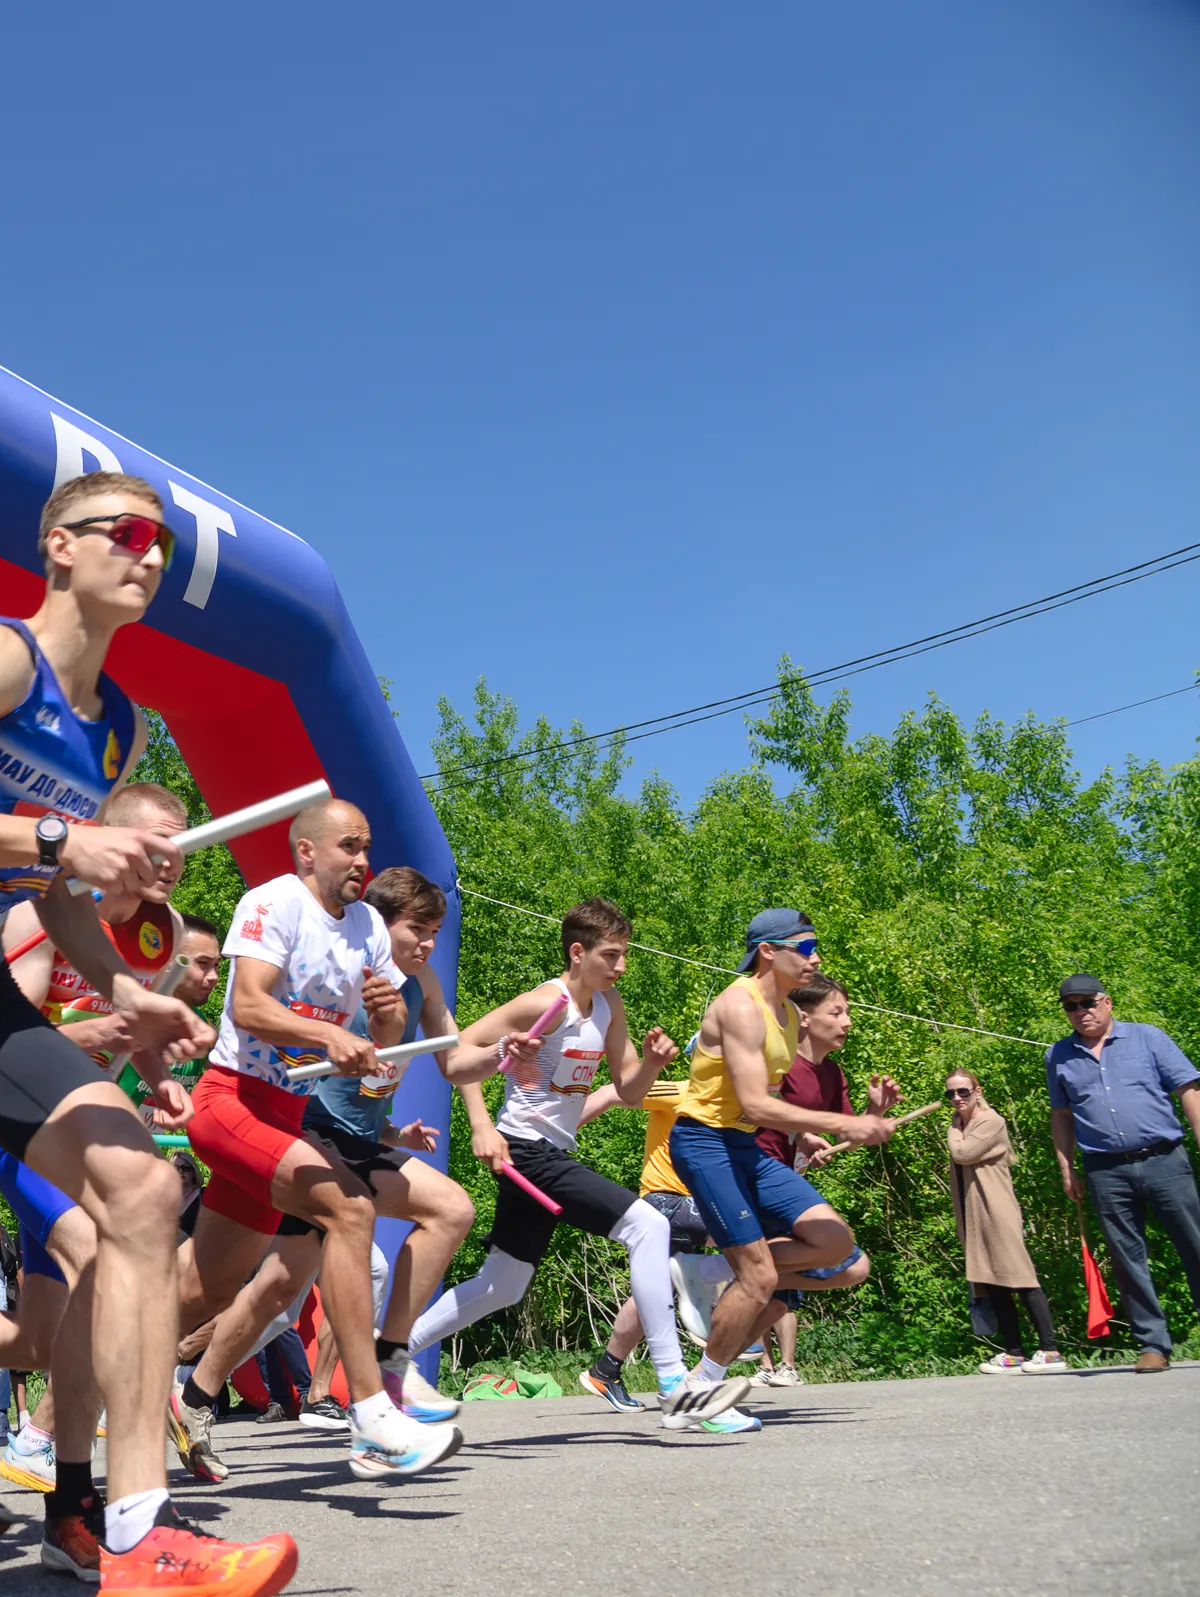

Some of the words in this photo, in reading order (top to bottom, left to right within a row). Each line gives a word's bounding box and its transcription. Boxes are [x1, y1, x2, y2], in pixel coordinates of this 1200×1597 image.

[26, 773, 57, 797] ДО
[91, 1000, 99, 1012] 9
[312, 1007, 319, 1017] 9
